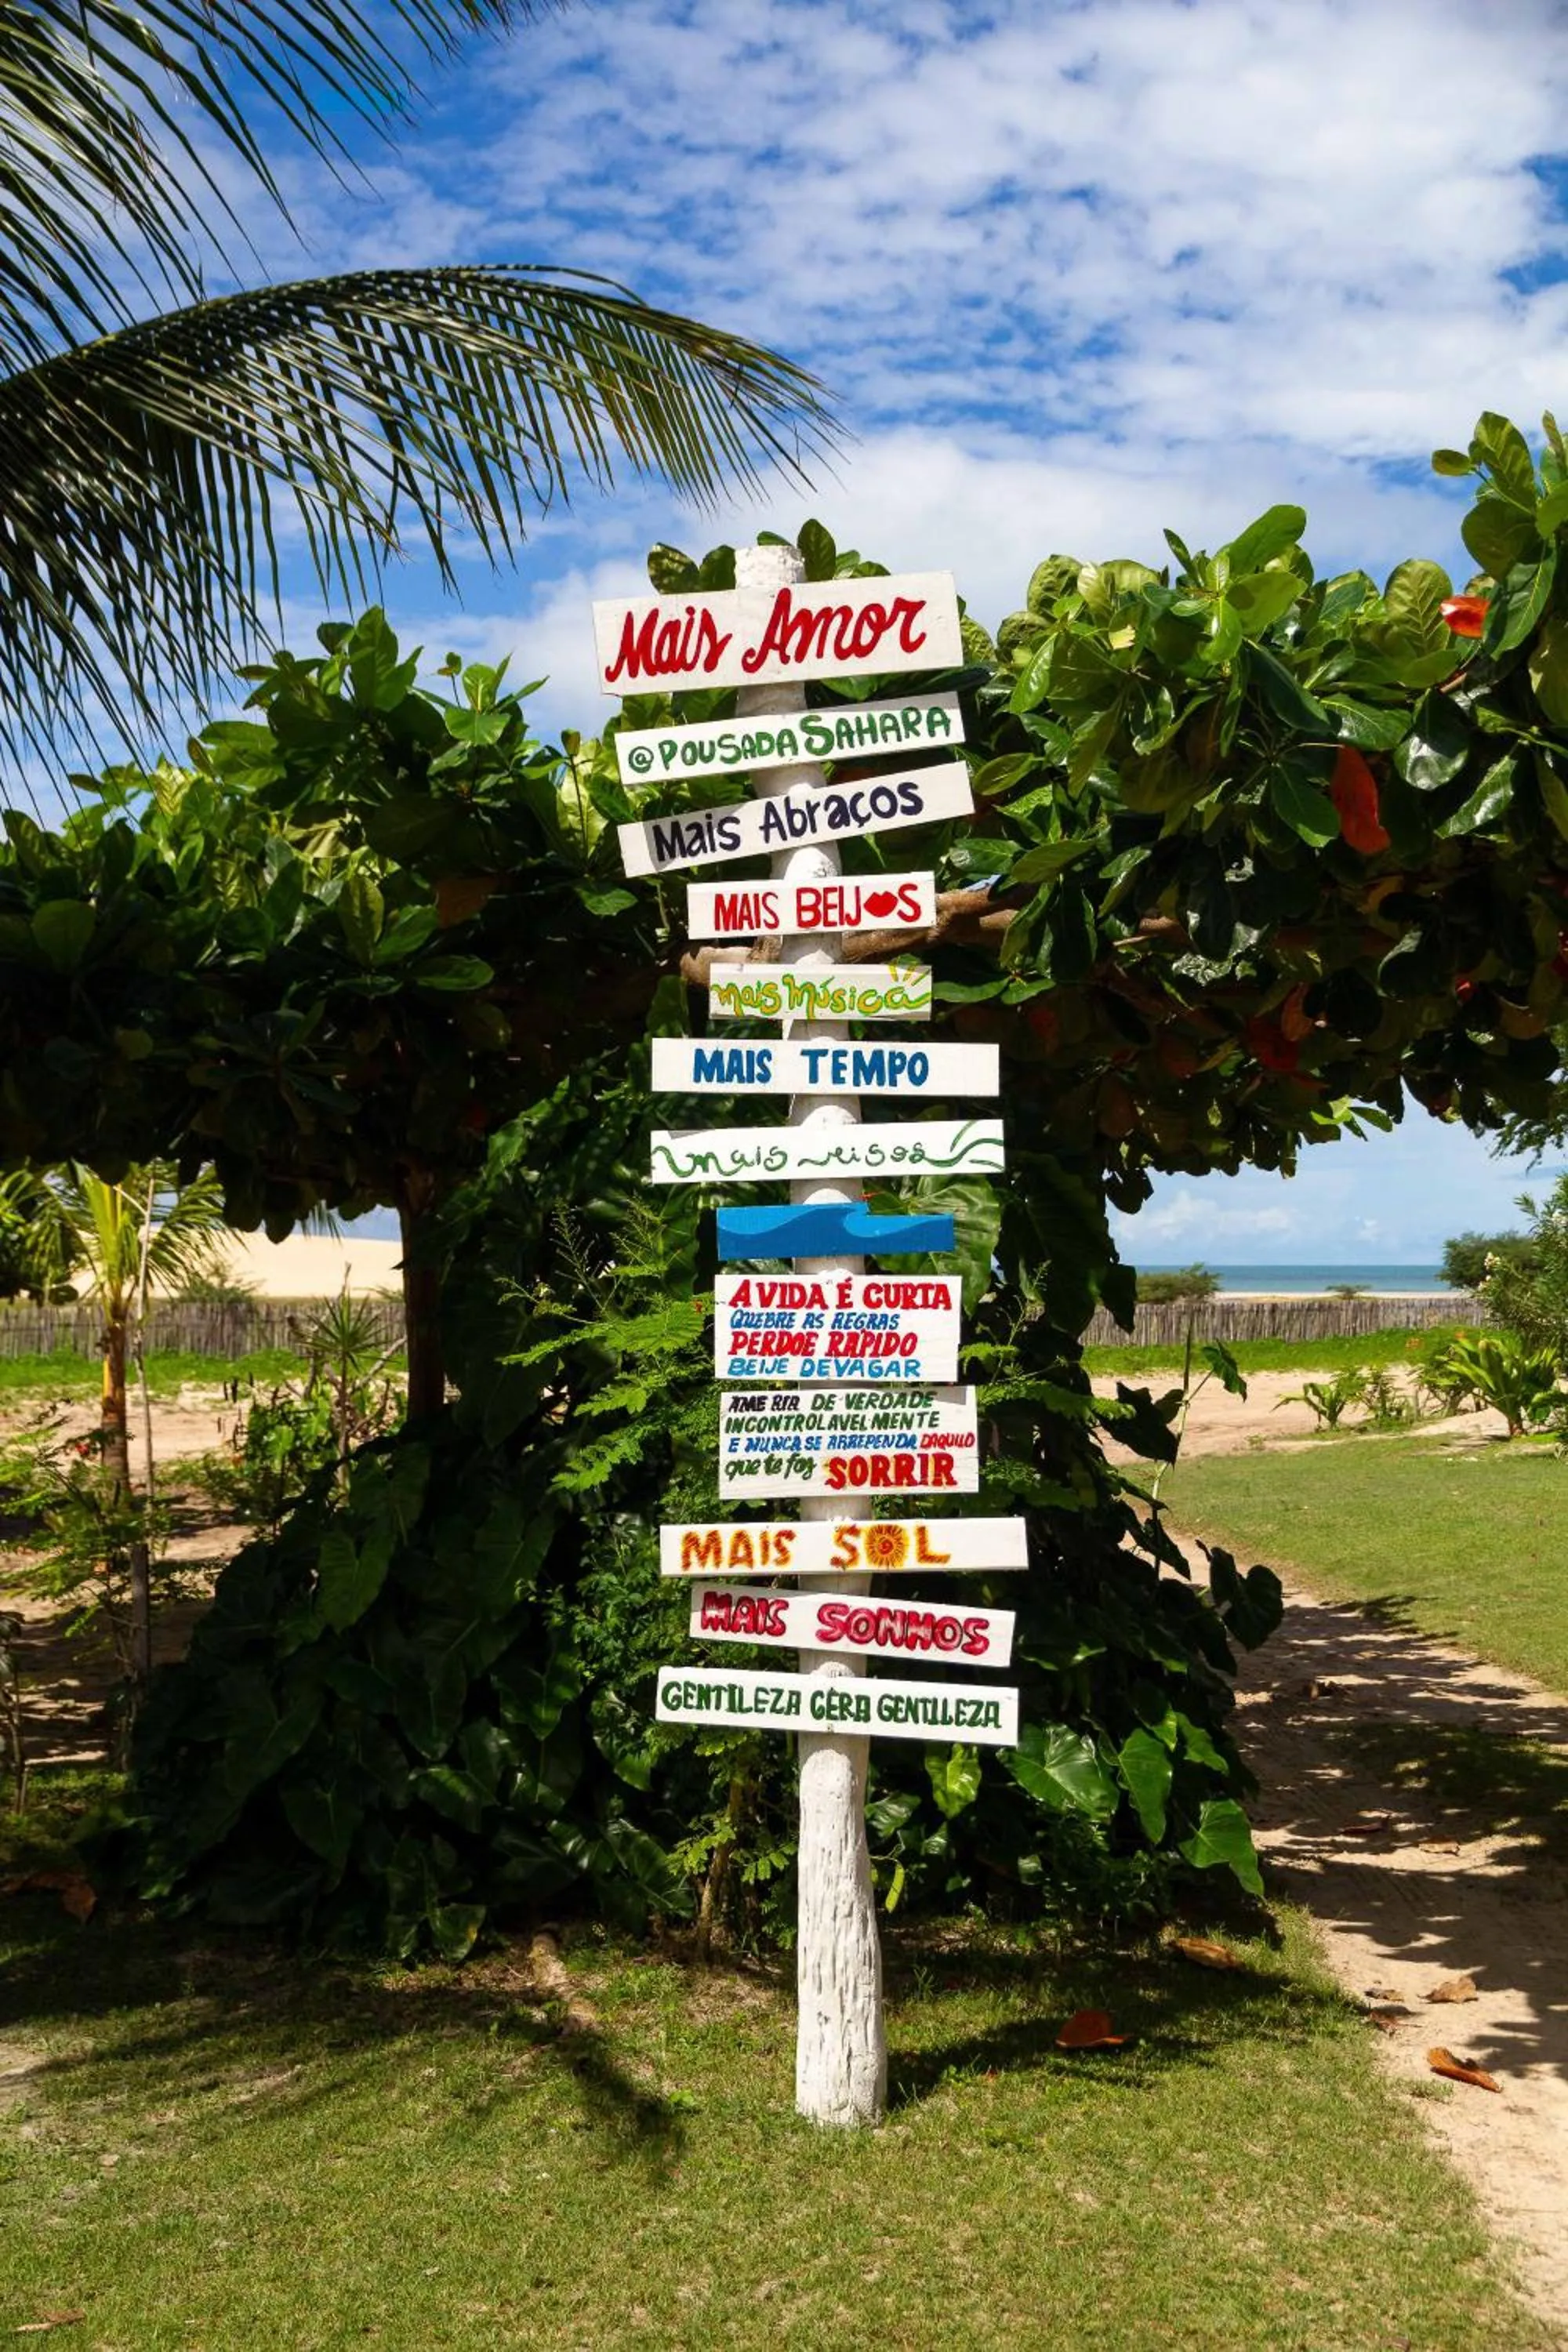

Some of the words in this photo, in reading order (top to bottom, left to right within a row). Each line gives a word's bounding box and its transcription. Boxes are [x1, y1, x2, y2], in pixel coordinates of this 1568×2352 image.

[605, 606, 732, 682] Mais
[742, 587, 926, 673] Amor
[653, 814, 740, 862] Mais
[759, 782, 924, 844] Abraços
[714, 891, 779, 931] MAIS
[693, 1048, 772, 1083] MAIS
[800, 1048, 929, 1087] TEMPO
[728, 1279, 753, 1308] A
[755, 1282, 829, 1310] VIDA
[836, 1276, 854, 1310] É
[862, 1282, 953, 1311] CURTA
[730, 1309, 796, 1330] QUEBRE
[802, 1312, 825, 1330] AS
[831, 1312, 901, 1330] REGRAS
[728, 1331, 819, 1356] PERDOE
[728, 1357, 789, 1376] BEIJE
[800, 1359, 922, 1377] DEVAGAR
[728, 1396, 768, 1413] AME
[771, 1394, 800, 1411] RIR
[811, 1393, 837, 1411] DE
[844, 1390, 938, 1410] VERDADE
[728, 1437, 741, 1453] E
[745, 1435, 802, 1453] NUNCA
[806, 1435, 822, 1451] SE
[827, 1433, 918, 1450] ARREPENDA
[724, 1457, 760, 1481] que
[764, 1453, 782, 1475] te
[824, 1451, 958, 1490] SORRIR
[681, 1528, 797, 1572] MAIS
[701, 1591, 789, 1636] MAIS
[815, 1602, 990, 1656] SONHOS
[661, 1680, 801, 1715] GENTILEZA
[877, 1693, 1003, 1730] GENTILEZA
